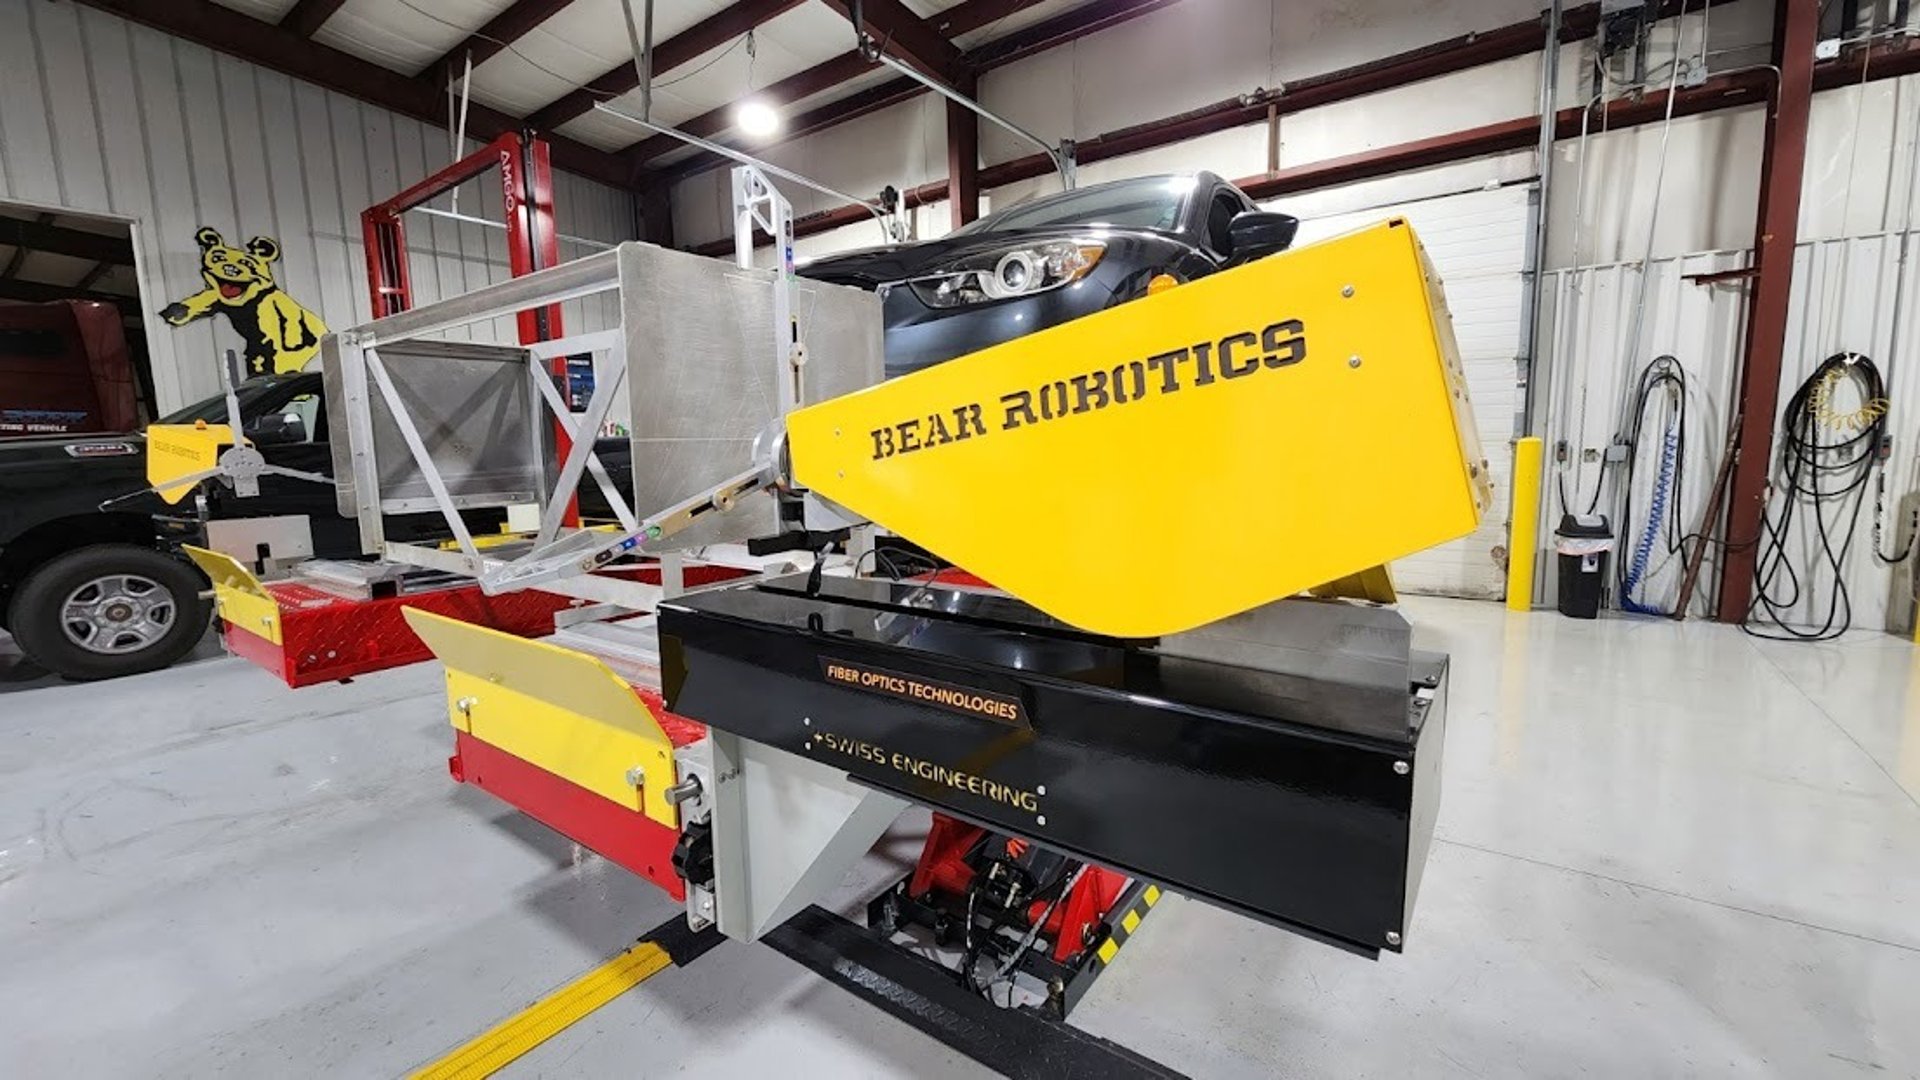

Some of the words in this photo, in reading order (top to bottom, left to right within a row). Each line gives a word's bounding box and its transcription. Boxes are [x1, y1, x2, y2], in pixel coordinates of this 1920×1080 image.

[501, 150, 515, 212] AMGO
[870, 402, 987, 461] BEAR
[1001, 318, 1307, 431] ROBOTICS
[27, 424, 68, 433] VEHICLE
[827, 664, 860, 683] FIBER
[860, 671, 906, 693] OPTICS
[906, 680, 1018, 721] TECHNOLOGIES
[891, 752, 1038, 812] ENGINEERING
